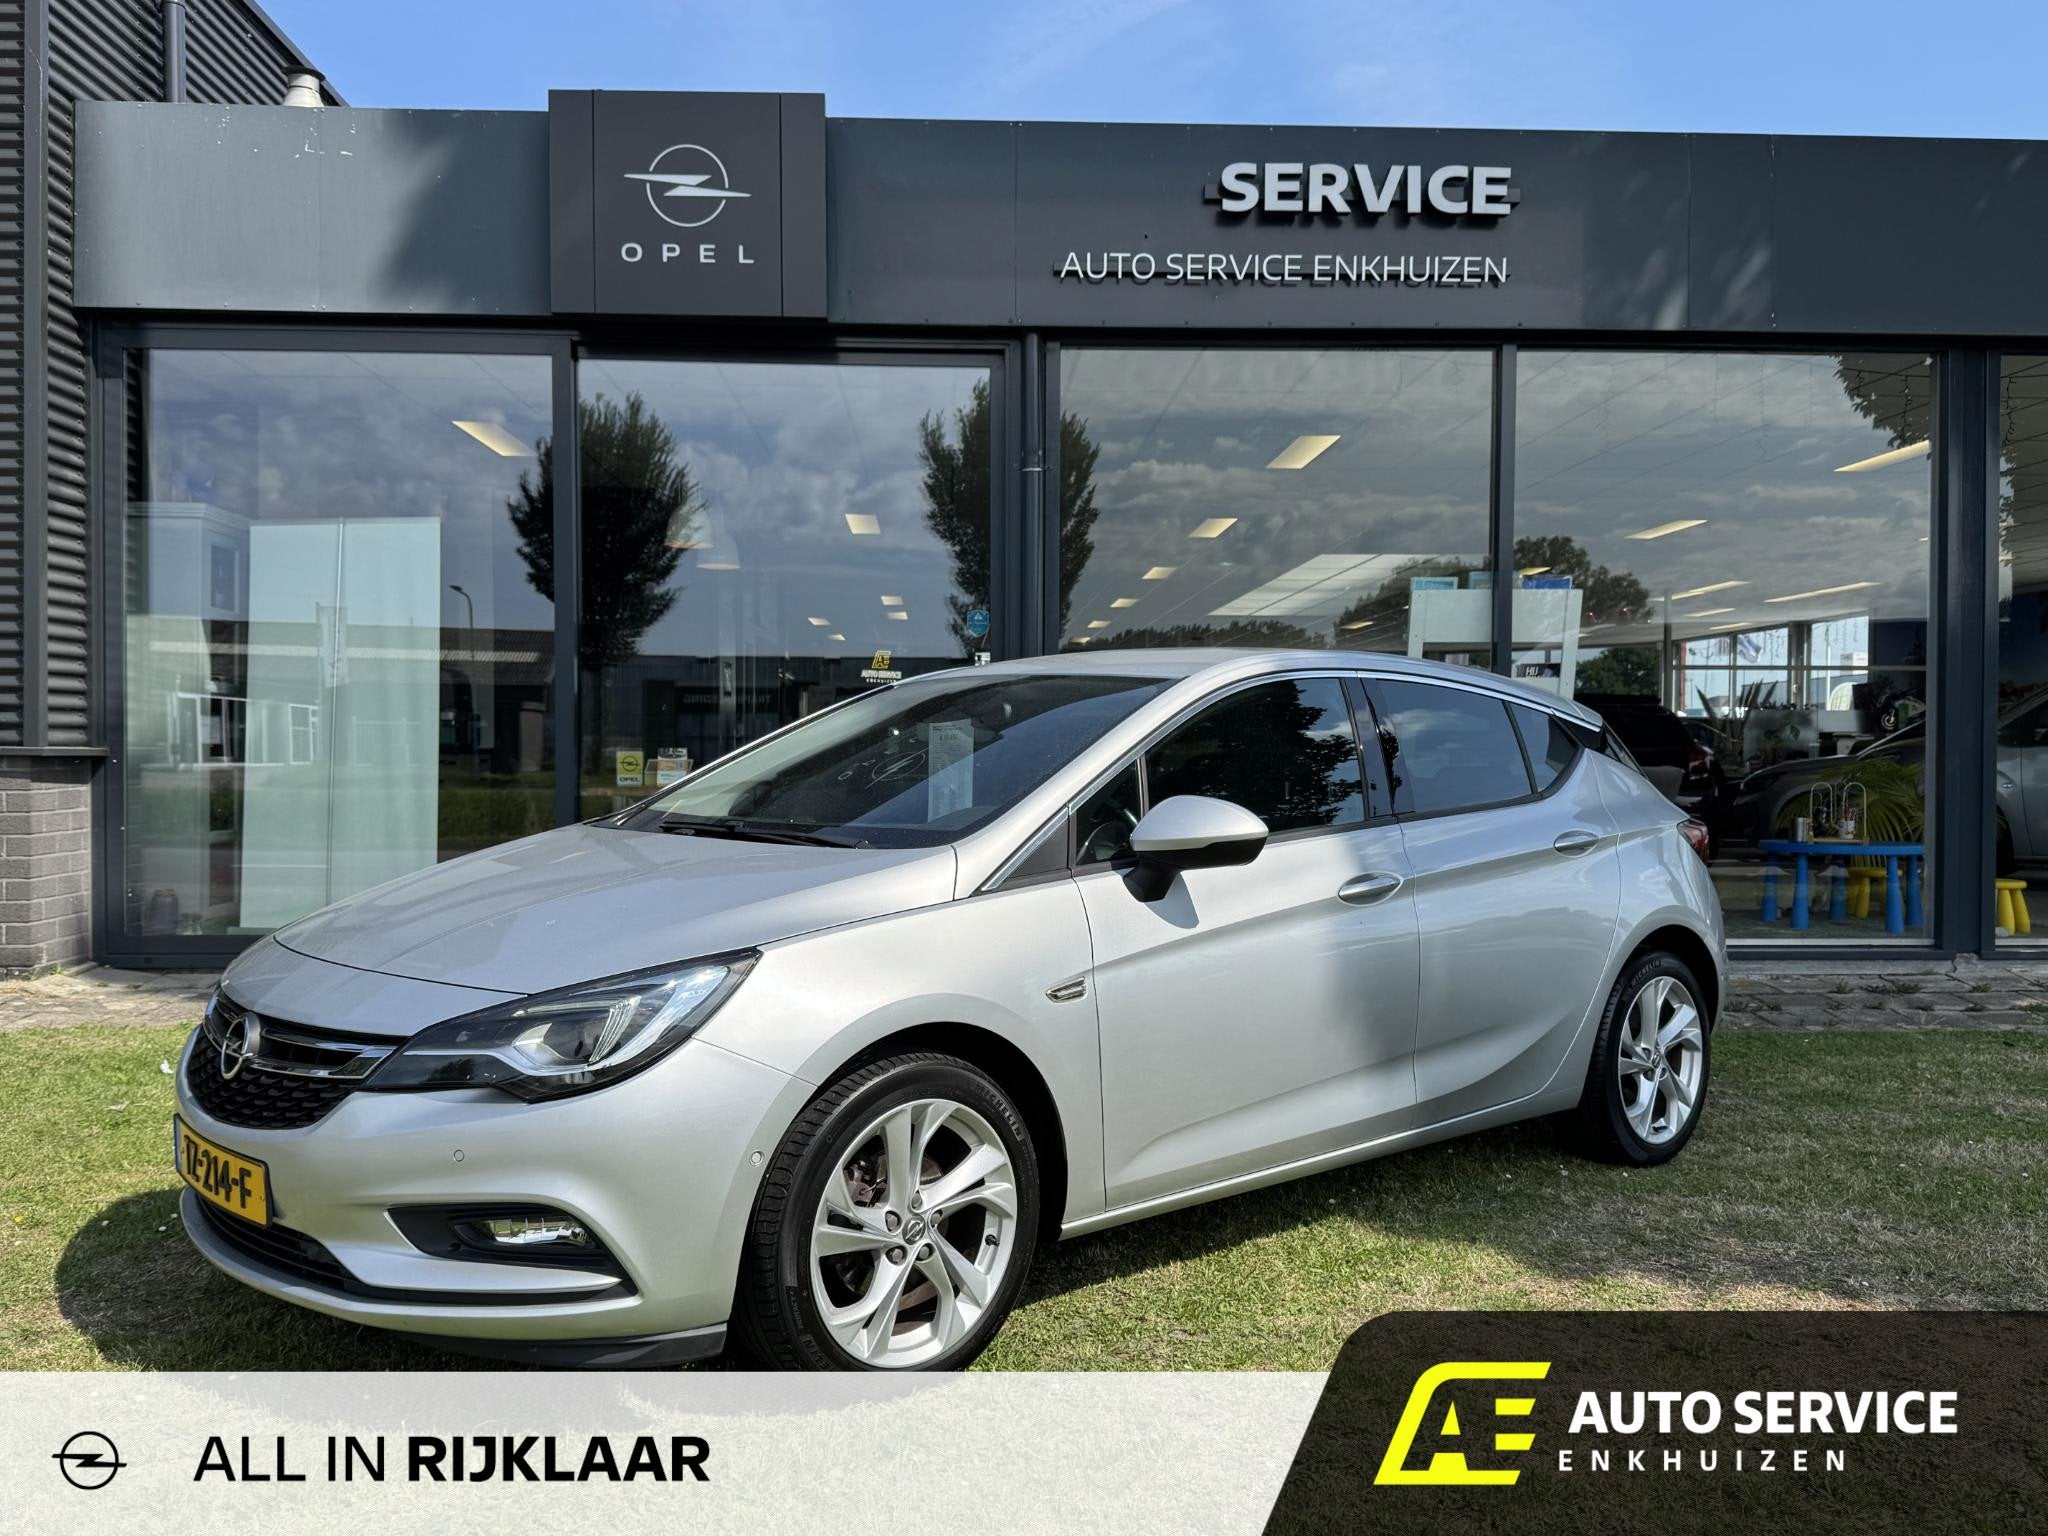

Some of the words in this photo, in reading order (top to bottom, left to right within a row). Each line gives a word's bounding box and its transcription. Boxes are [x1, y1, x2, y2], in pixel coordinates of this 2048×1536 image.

[1220, 161, 1512, 215] SERVICE
[620, 242, 755, 264] OPEL
[1060, 252, 1156, 280] AUTO
[1166, 253, 1302, 281] SERVICE
[1313, 254, 1507, 283] ENKHUIZEN
[976, 1083, 1024, 1142] MICHELIN
